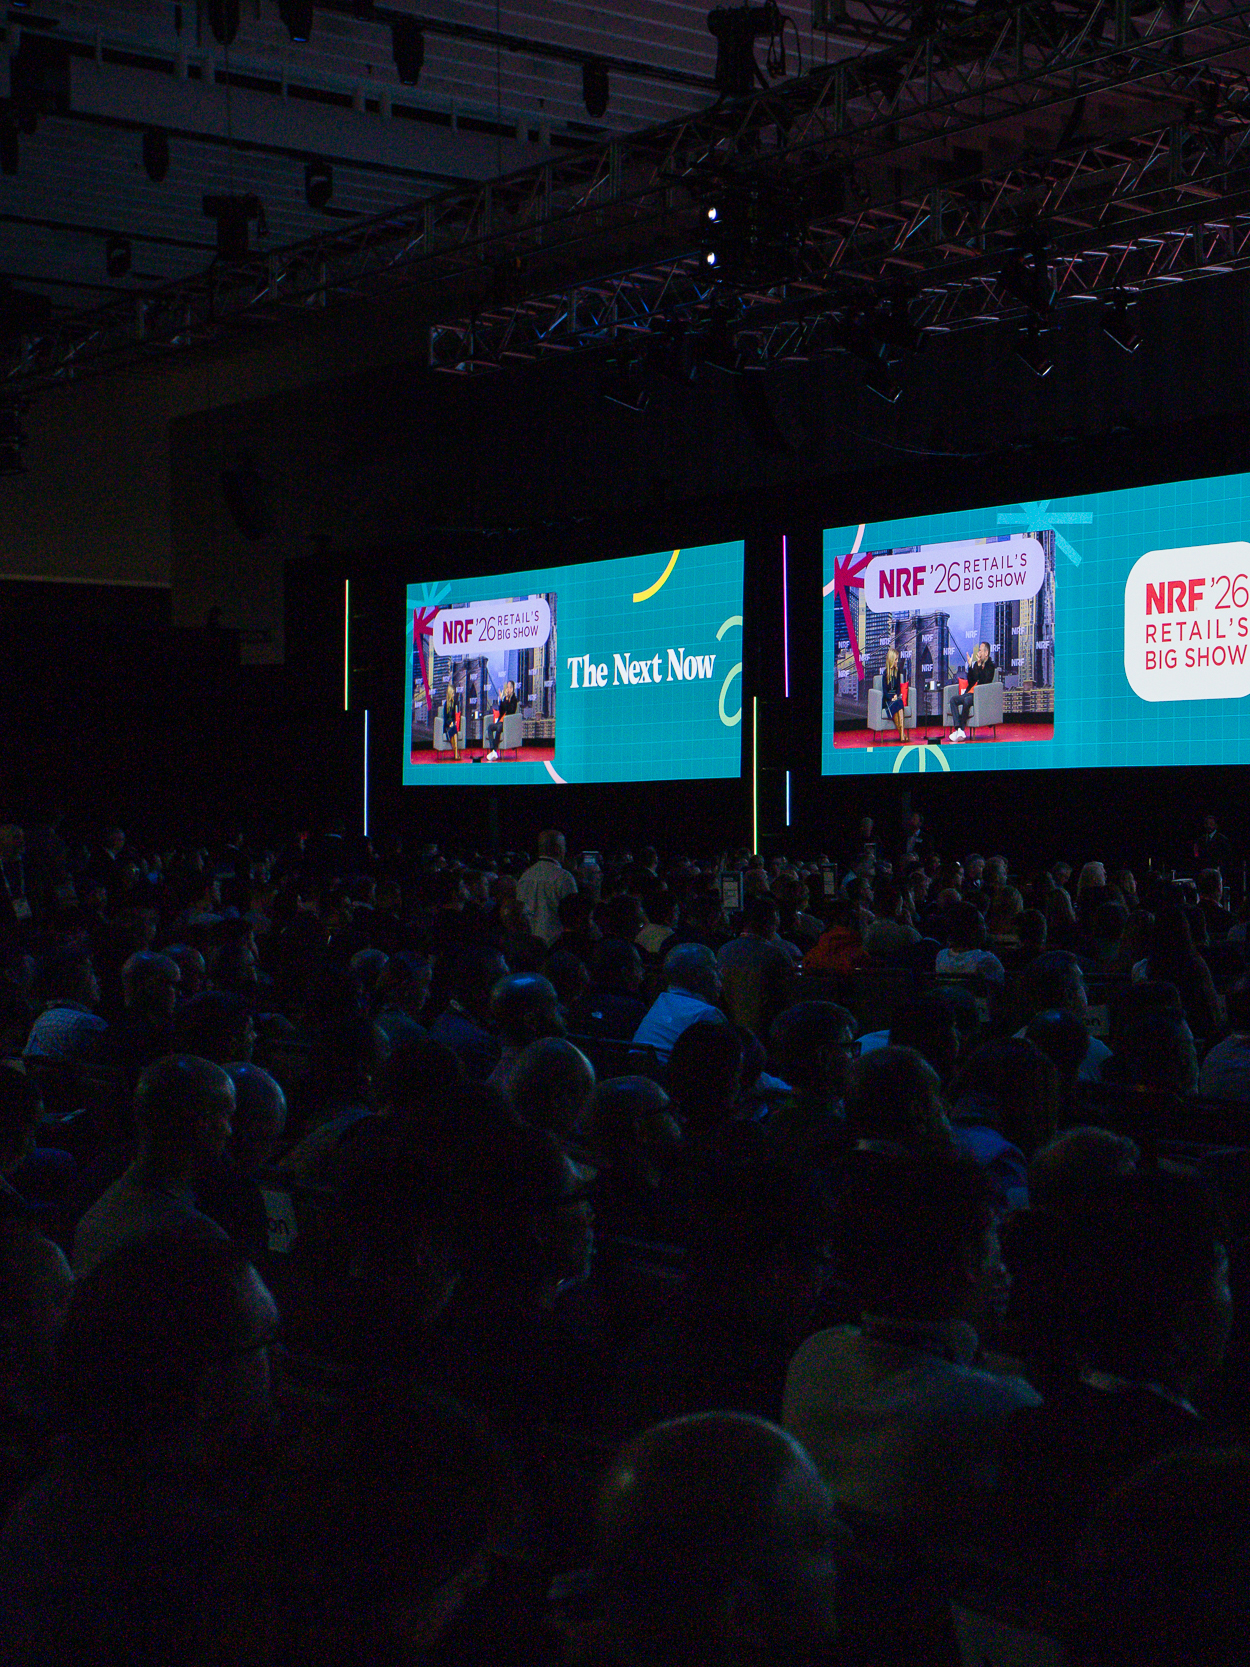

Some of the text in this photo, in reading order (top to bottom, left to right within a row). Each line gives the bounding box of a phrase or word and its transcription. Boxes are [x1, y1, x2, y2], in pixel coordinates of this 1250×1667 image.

[964, 553, 1028, 574] RETAIL’S
[879, 566, 927, 599] NRF
[964, 571, 1027, 591] BIG SHOW
[1145, 578, 1206, 615] NRF
[497, 610, 540, 626] RETAIL’S
[1145, 617, 1249, 644] RETAIL’S
[443, 619, 474, 645] NRF
[497, 625, 539, 640] BIG SHOW
[567, 648, 716, 688] The Next Now
[1145, 645, 1248, 670] BIG SHOW
